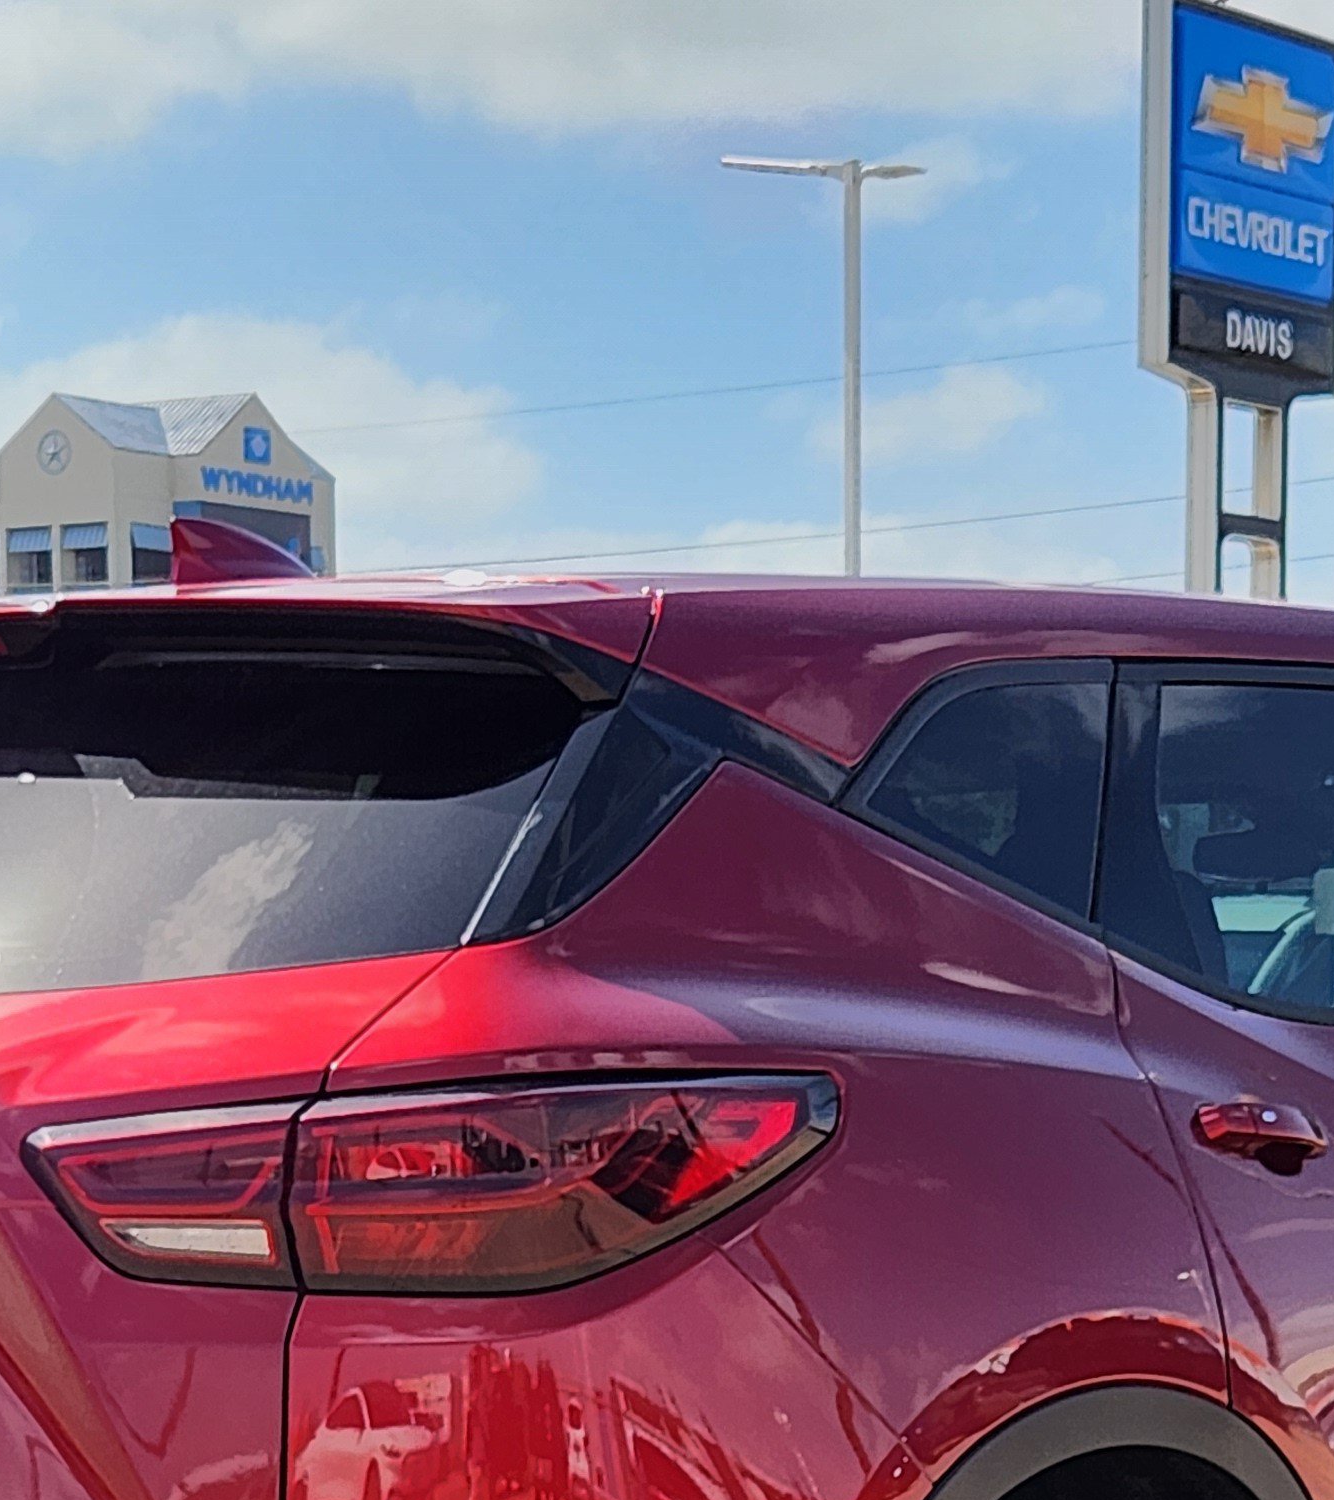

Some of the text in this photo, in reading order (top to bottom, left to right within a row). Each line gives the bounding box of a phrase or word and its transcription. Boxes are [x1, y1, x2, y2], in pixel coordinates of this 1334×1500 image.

[1186, 196, 1331, 268] CHEVROLET
[1225, 308, 1293, 361] DAVIS
[200, 465, 314, 507] WYNDHAM
